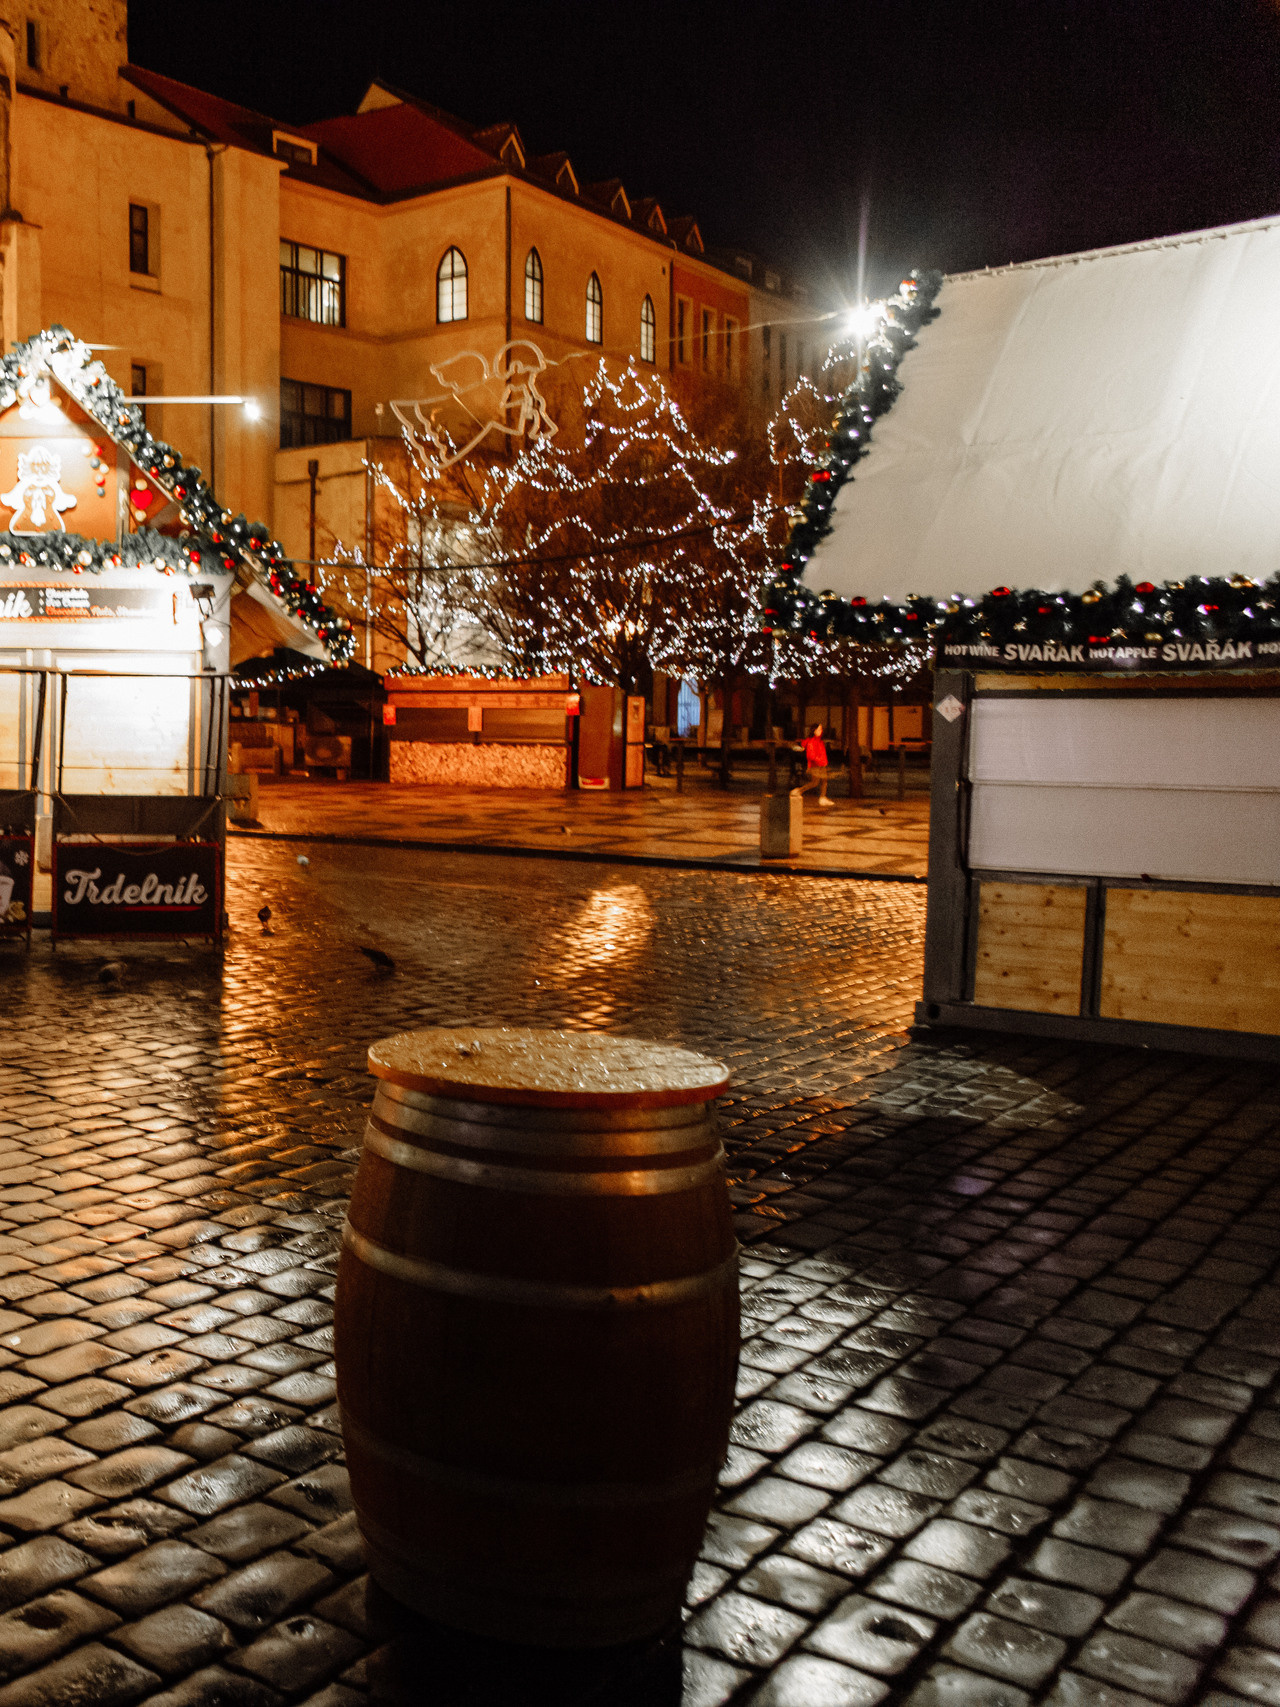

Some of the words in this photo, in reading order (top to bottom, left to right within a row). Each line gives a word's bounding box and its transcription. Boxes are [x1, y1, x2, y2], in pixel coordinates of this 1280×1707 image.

[944, 644, 969, 656] HOT
[969, 645, 1000, 657] WINE
[1114, 647, 1158, 659] APPLE
[1161, 638, 1253, 662] SVAŘÁK
[1257, 641, 1280, 654] HO
[63, 867, 209, 905] Trdelnik
